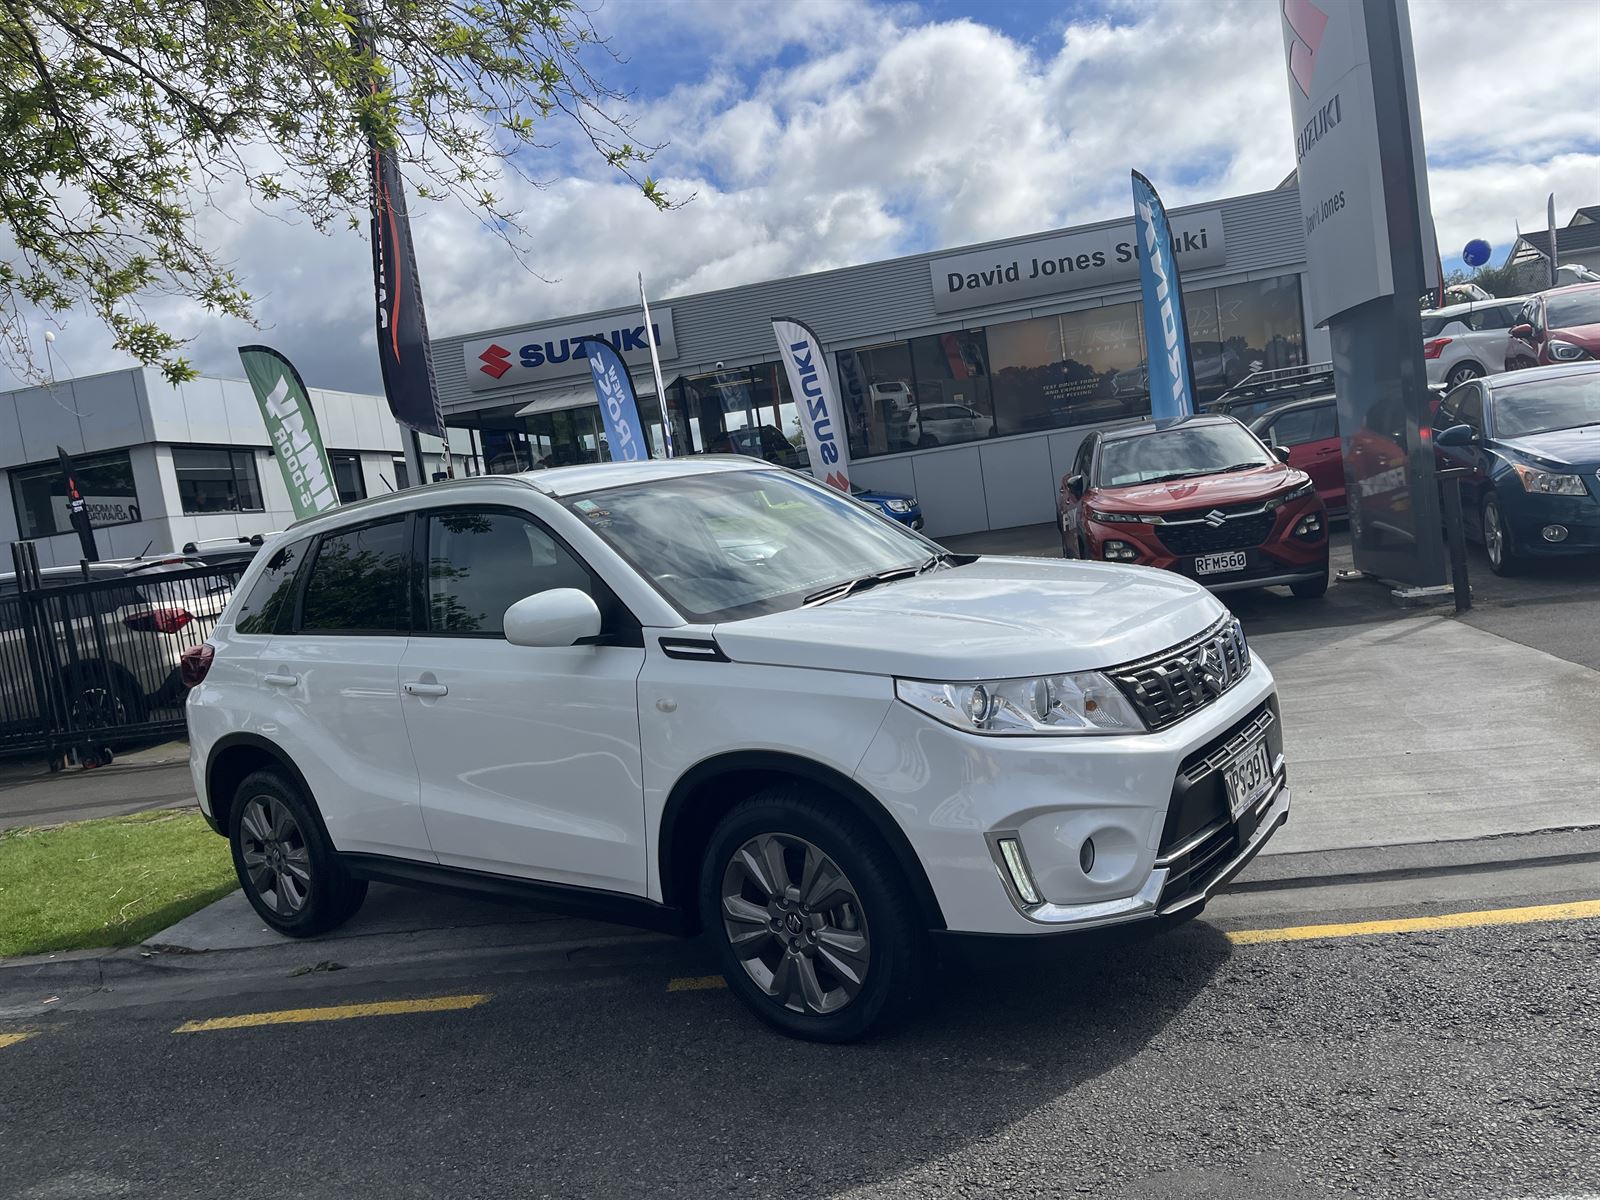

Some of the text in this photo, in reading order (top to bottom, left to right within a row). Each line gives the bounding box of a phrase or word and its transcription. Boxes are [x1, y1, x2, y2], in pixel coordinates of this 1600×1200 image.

[1321, 190, 1346, 223] Jones
[948, 229, 1208, 293] David Jones Ski
[1196, 553, 1245, 571] RFM560
[1225, 748, 1269, 811] NPS391
